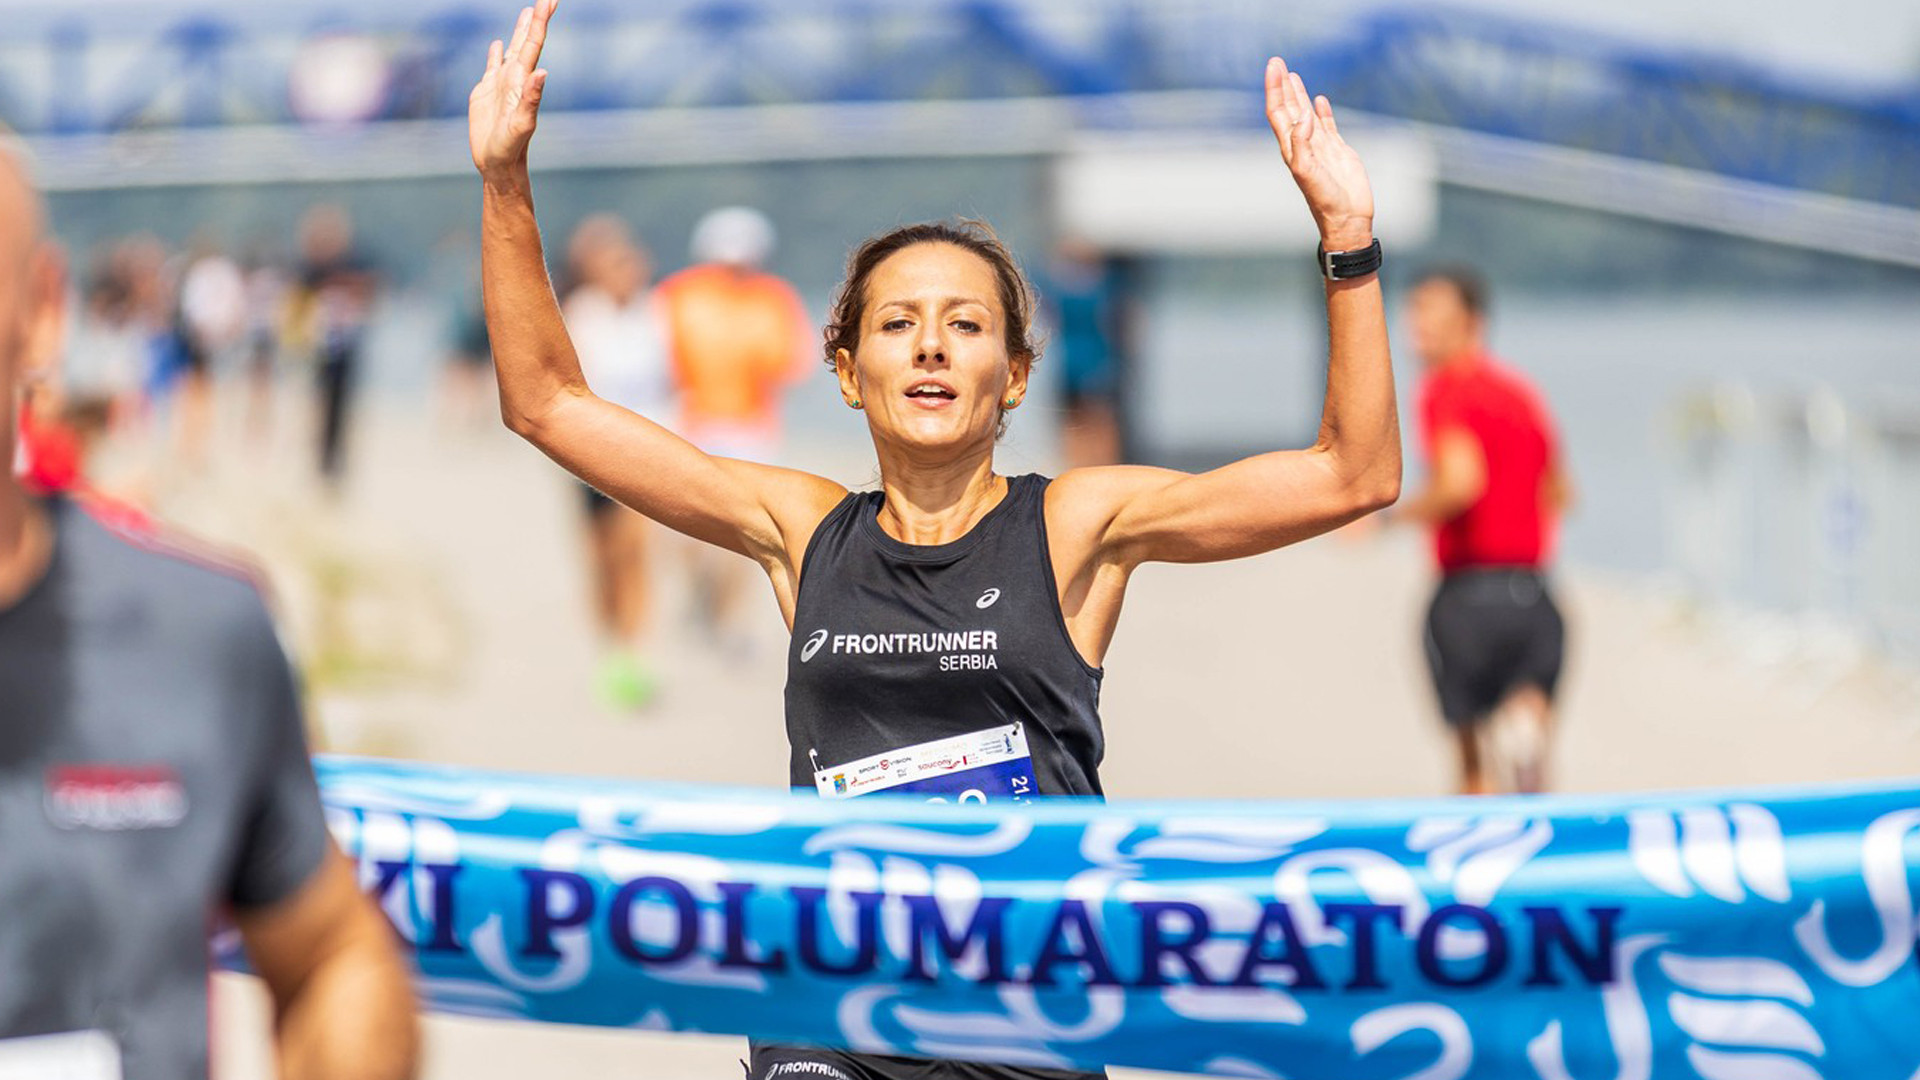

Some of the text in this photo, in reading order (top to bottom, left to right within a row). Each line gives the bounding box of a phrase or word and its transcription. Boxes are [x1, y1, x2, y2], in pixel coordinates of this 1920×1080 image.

[832, 631, 998, 654] FRONTRUNNER
[939, 655, 998, 671] SERBIA
[520, 866, 1626, 990] POLUMARATON
